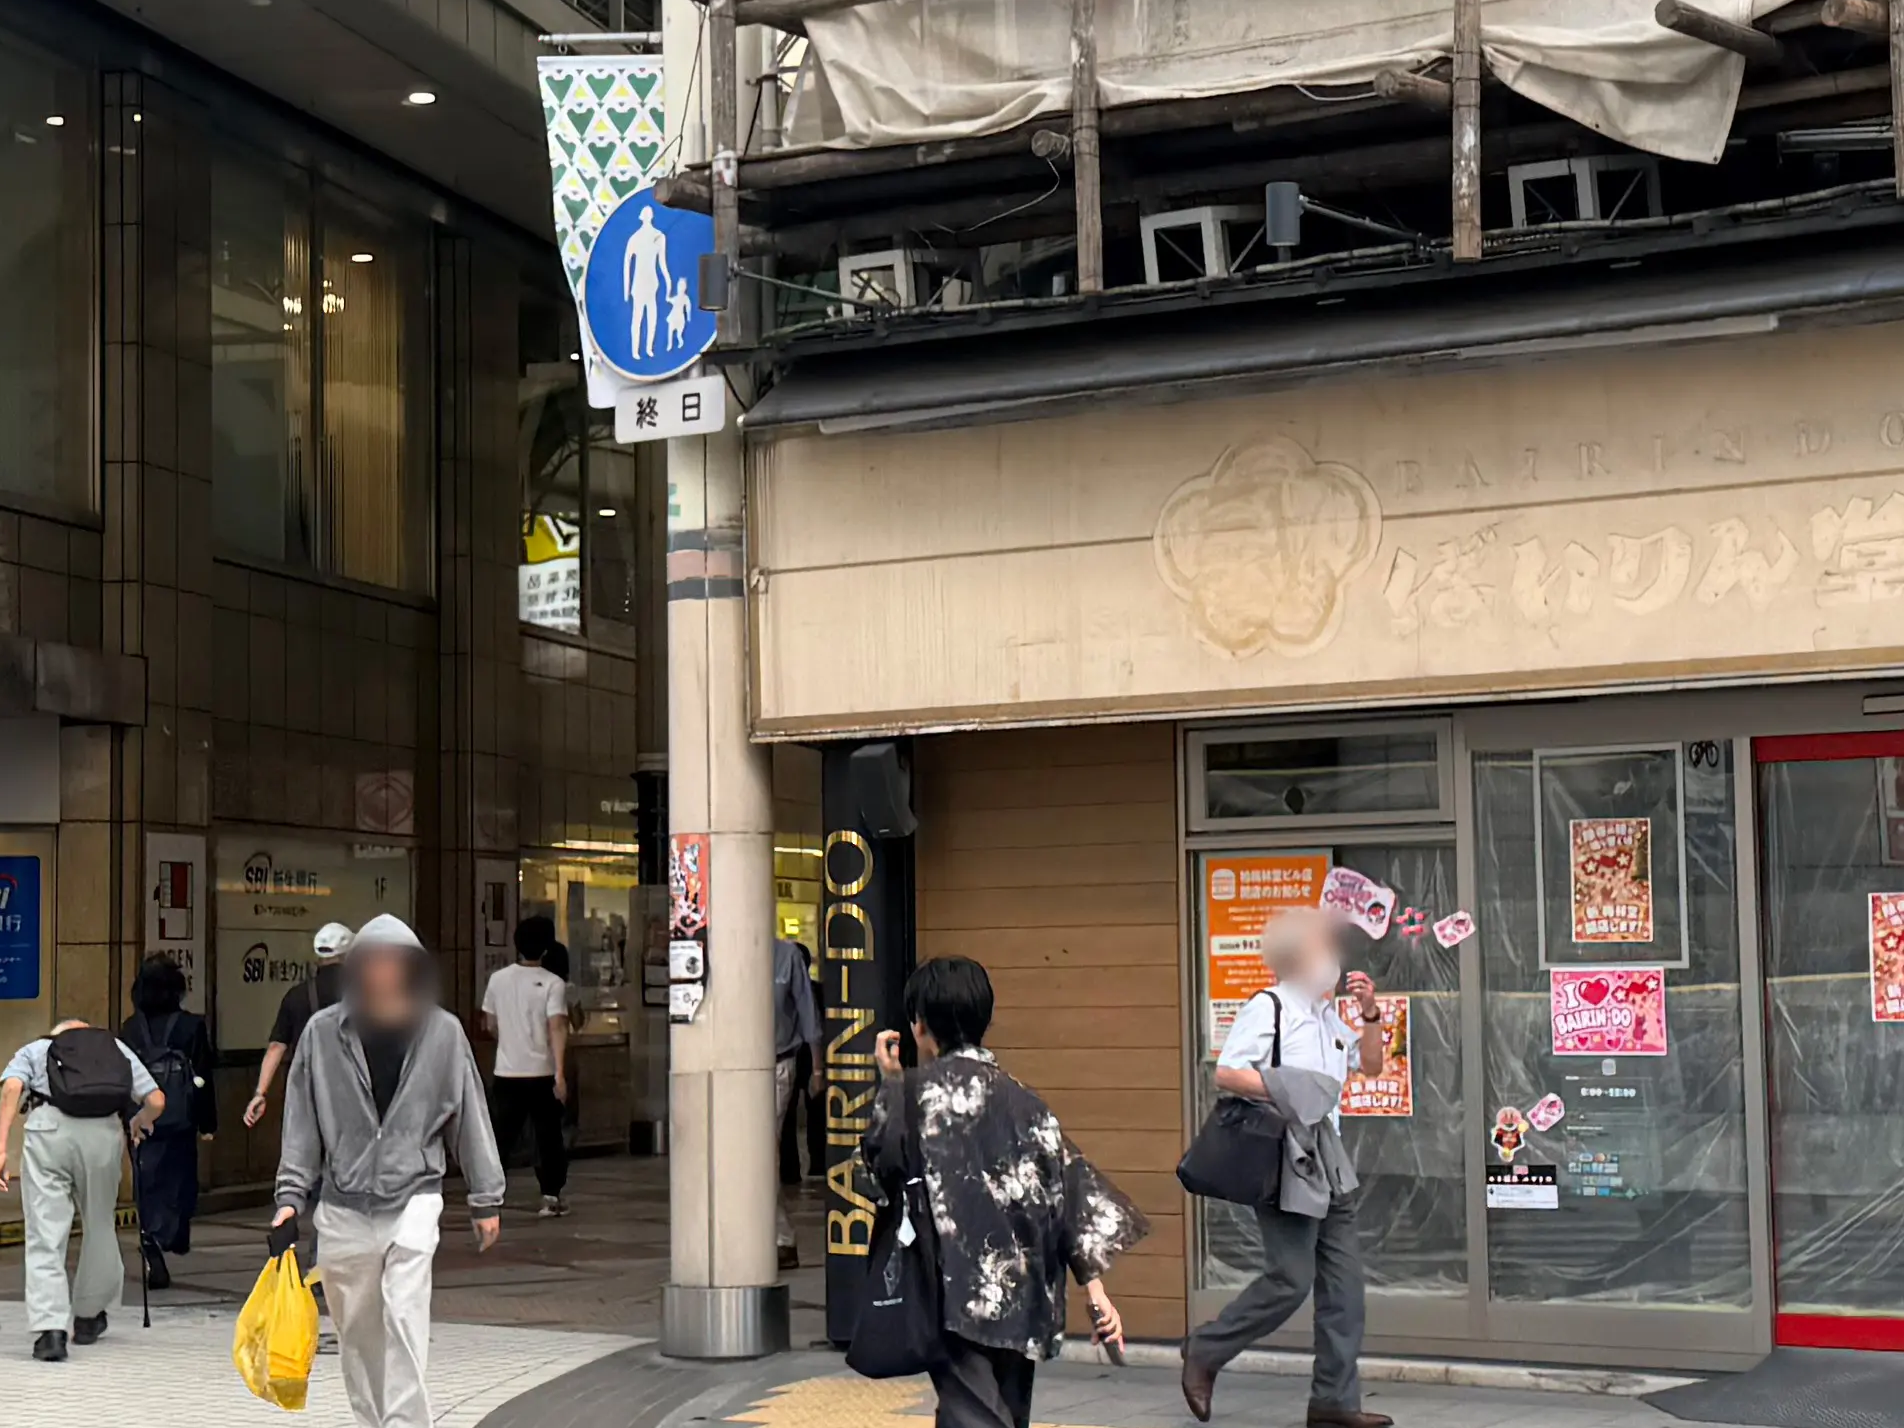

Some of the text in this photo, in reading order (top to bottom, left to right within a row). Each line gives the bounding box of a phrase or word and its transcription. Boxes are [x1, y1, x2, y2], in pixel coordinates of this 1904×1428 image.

[635, 392, 702, 429] 終日
[245, 866, 269, 894] SBI
[242, 958, 266, 984] SBI
[1563, 983, 1579, 1009] I
[823, 828, 876, 1256] BAIRIN-DO
